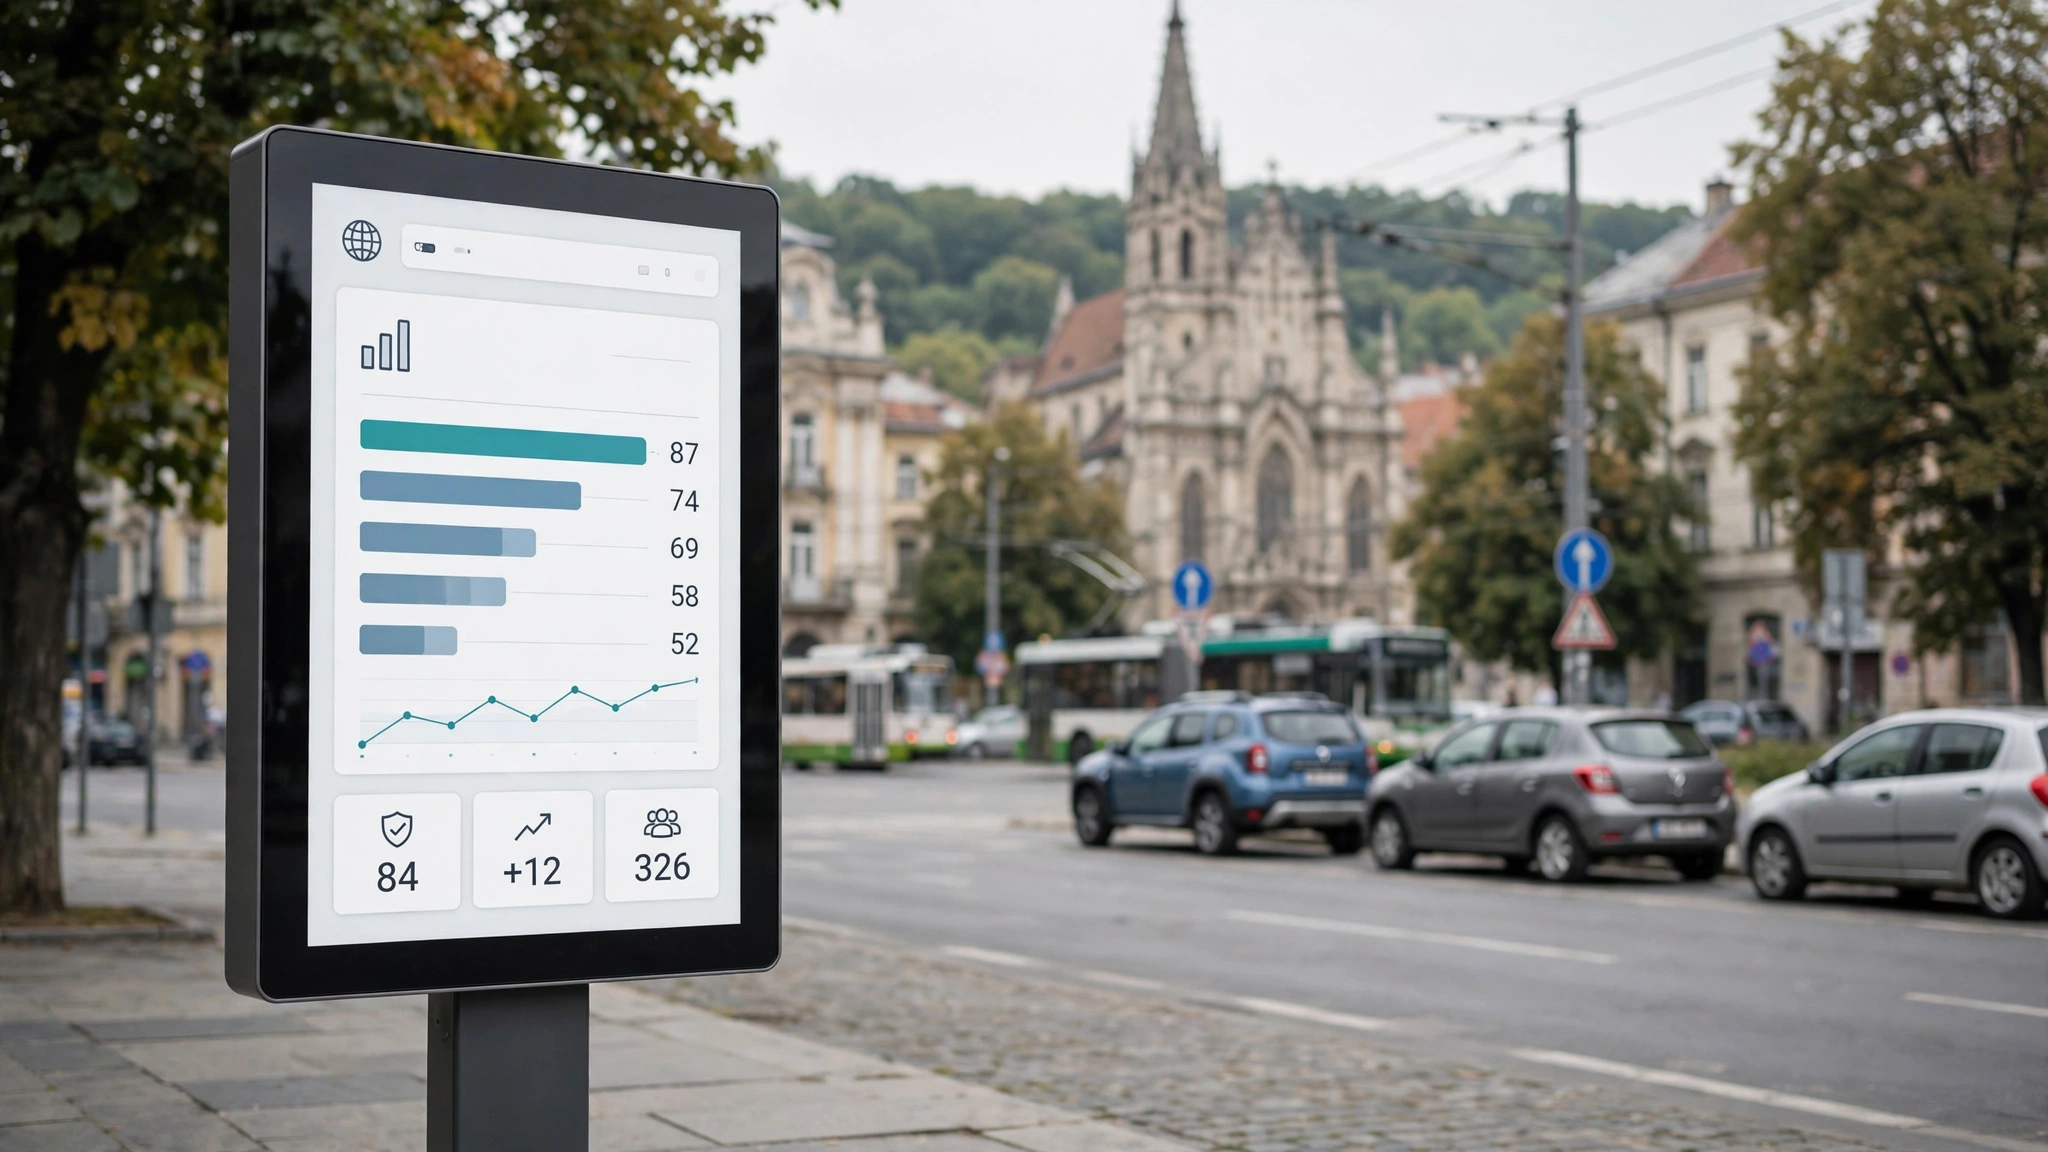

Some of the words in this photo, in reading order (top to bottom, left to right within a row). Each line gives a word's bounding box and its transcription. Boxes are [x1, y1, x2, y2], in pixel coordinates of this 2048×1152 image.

[670, 441, 699, 465] 87
[670, 488, 700, 513] 74
[670, 536, 699, 560] 69
[671, 584, 699, 608] 58
[671, 632, 700, 655] 52
[377, 861, 419, 893] 84
[503, 856, 562, 886] +12
[634, 851, 691, 882] 326
